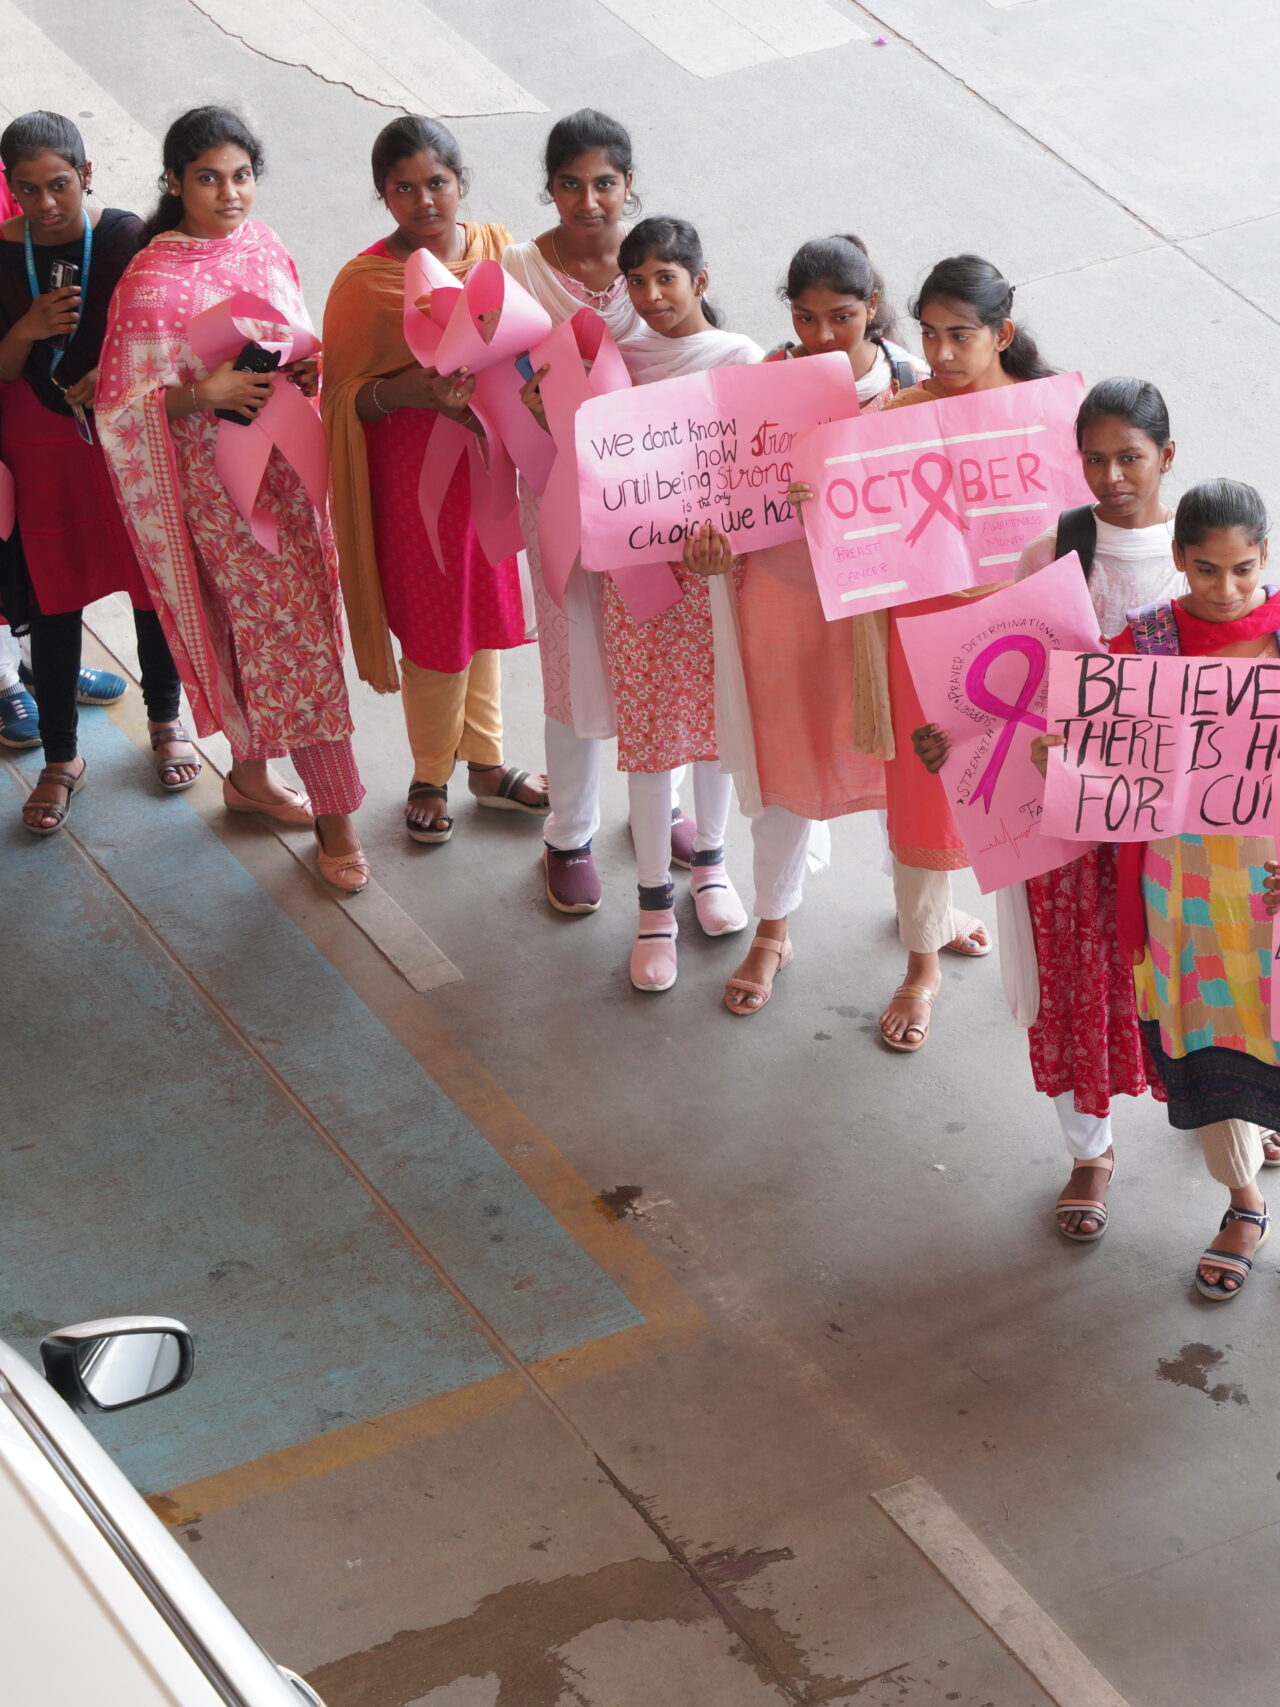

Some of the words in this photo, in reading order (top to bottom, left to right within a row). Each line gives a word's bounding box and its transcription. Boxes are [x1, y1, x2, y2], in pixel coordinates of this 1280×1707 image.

[642, 422, 682, 451] dont
[656, 470, 711, 500] being
[682, 500, 692, 514] is
[982, 514, 1043, 535] AWARENESS
[833, 543, 881, 563] BREAST
[986, 535, 1027, 549] MONTH
[835, 563, 889, 587] CANCER
[961, 618, 1051, 653] DETERMINATION
[948, 656, 965, 701] PRAYER
[1054, 719, 1175, 774] THERE
[1185, 720, 1224, 774] IS
[957, 728, 995, 798] STRENGTH
[1075, 774, 1164, 833] FOR
